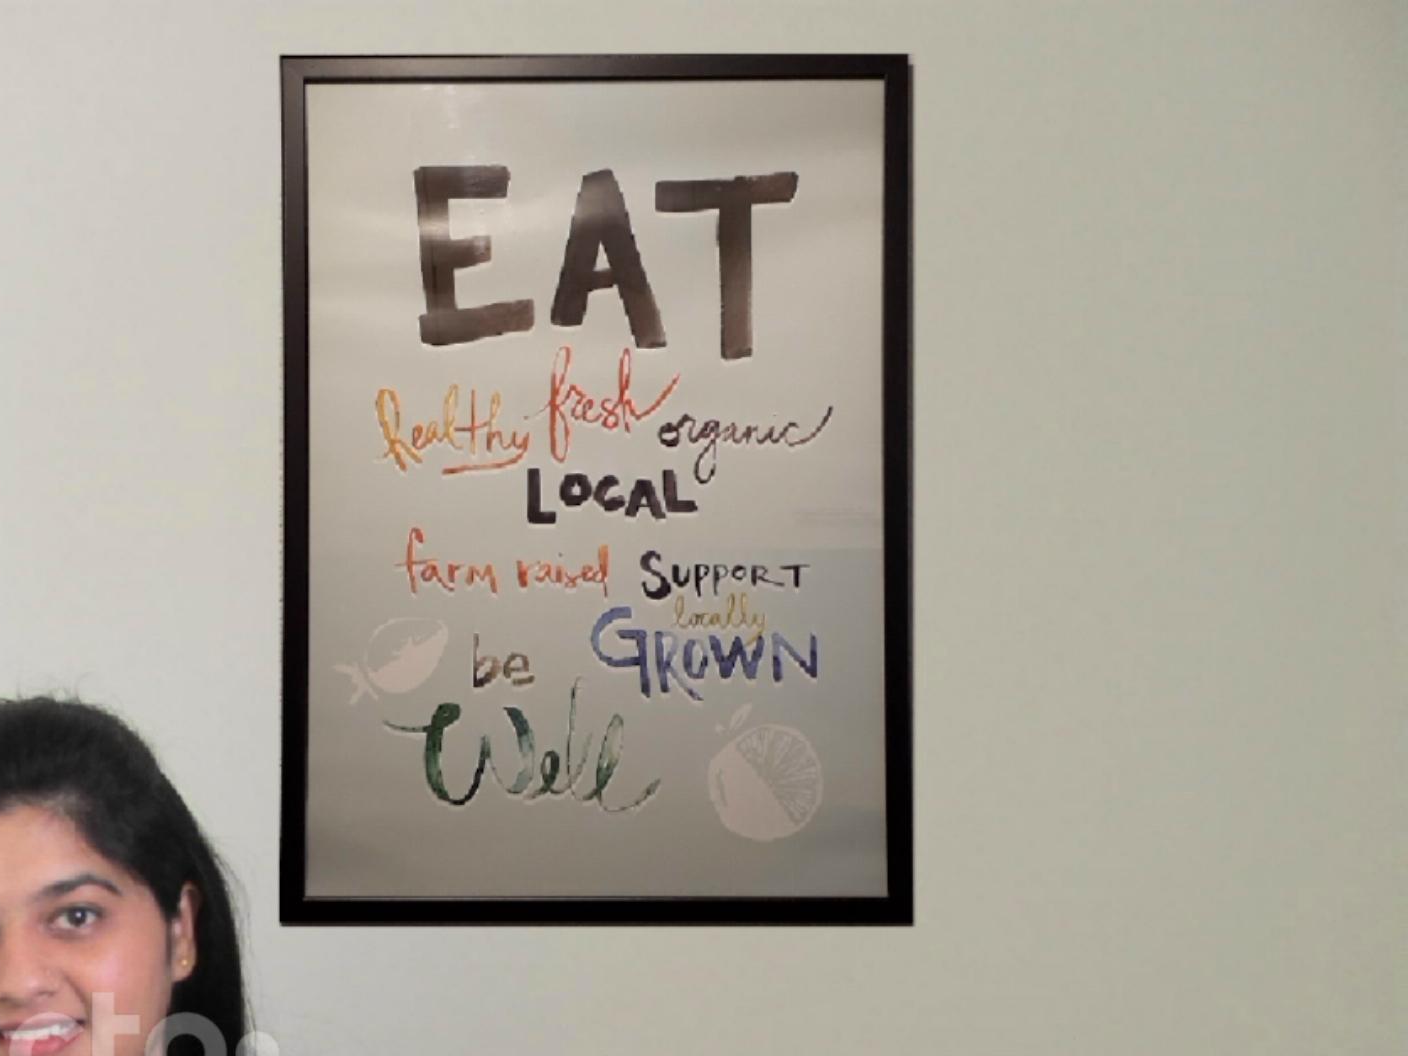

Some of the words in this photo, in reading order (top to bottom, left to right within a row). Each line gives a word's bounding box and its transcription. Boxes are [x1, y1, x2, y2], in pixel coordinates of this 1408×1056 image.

[413, 164, 799, 361] EAT
[375, 387, 531, 475] healthy
[540, 346, 681, 463] fresh
[658, 406, 834, 484] organic
[527, 467, 698, 524] LOCAL
[396, 527, 498, 594] farm
[517, 544, 611, 598] raised
[640, 550, 811, 600] SUPPORT
[672, 593, 768, 641] locally
[472, 633, 535, 688] be
[591, 606, 819, 701] GROWN
[382, 676, 661, 812] Well
